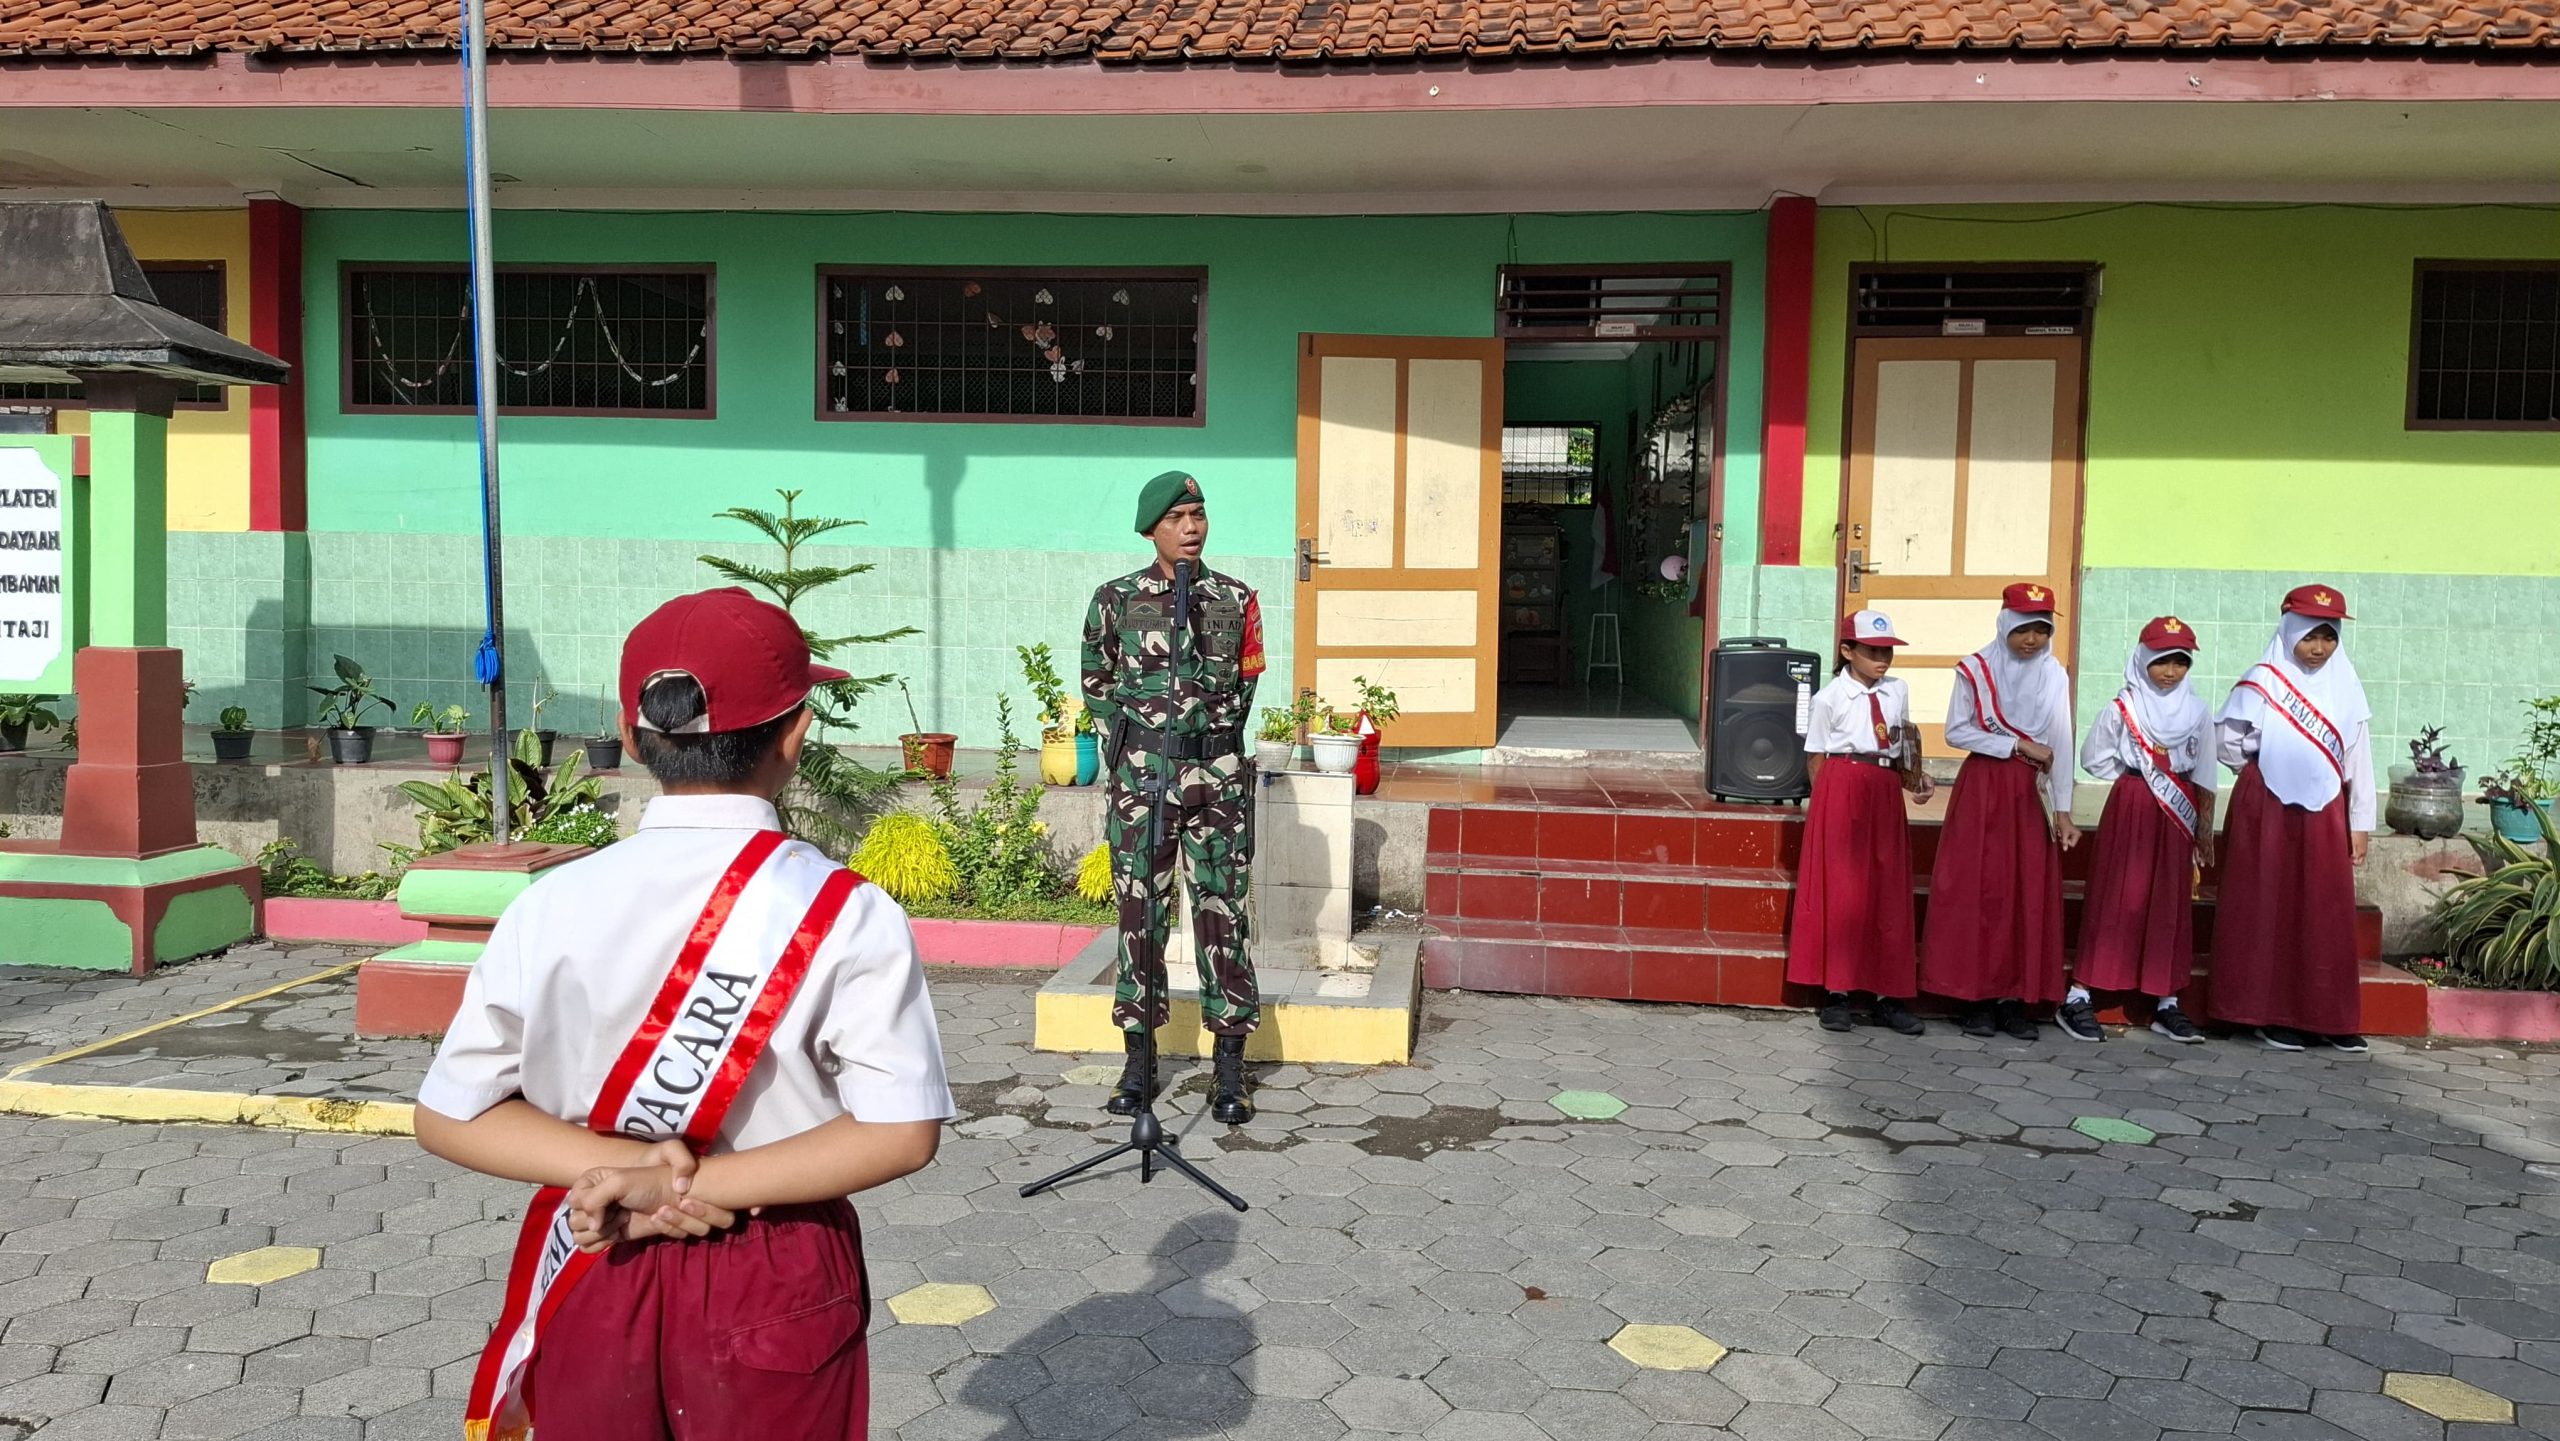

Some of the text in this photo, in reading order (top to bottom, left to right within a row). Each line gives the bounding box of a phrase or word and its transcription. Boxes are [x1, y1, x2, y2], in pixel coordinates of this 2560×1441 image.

[0, 620, 49, 638] TAJI
[2281, 691, 2338, 752] PEMBACA
[2170, 790, 2194, 820] UUD
